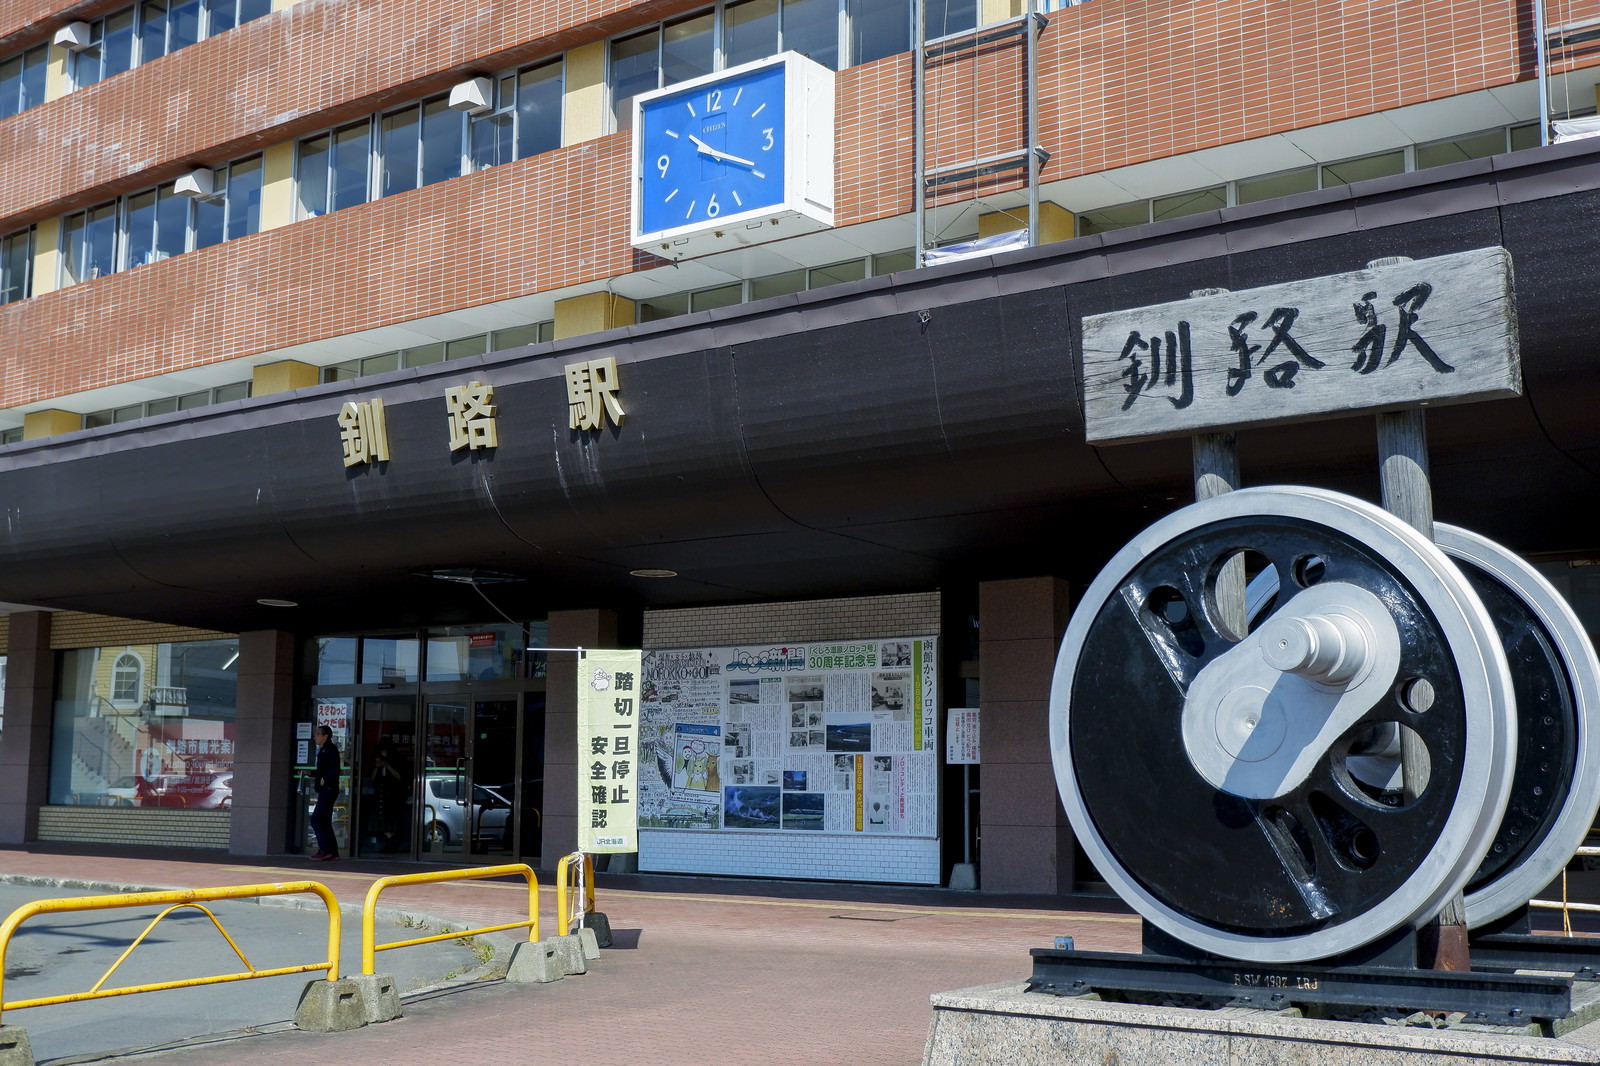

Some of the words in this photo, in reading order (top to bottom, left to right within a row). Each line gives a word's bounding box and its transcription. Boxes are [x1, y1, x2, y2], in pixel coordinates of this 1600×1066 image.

[706, 89, 722, 113] 12
[762, 128, 774, 151] 3
[657, 155, 670, 179] 9
[707, 193, 720, 218] 6
[1119, 282, 1455, 411] 釧路駅
[337, 356, 625, 468] 釧路駅
[809, 654, 877, 669] 30周年記念号
[611, 672, 634, 804] 踏切一旦停止
[590, 736, 608, 829] 安全確認
[596, 837, 624, 845] JR北海道
